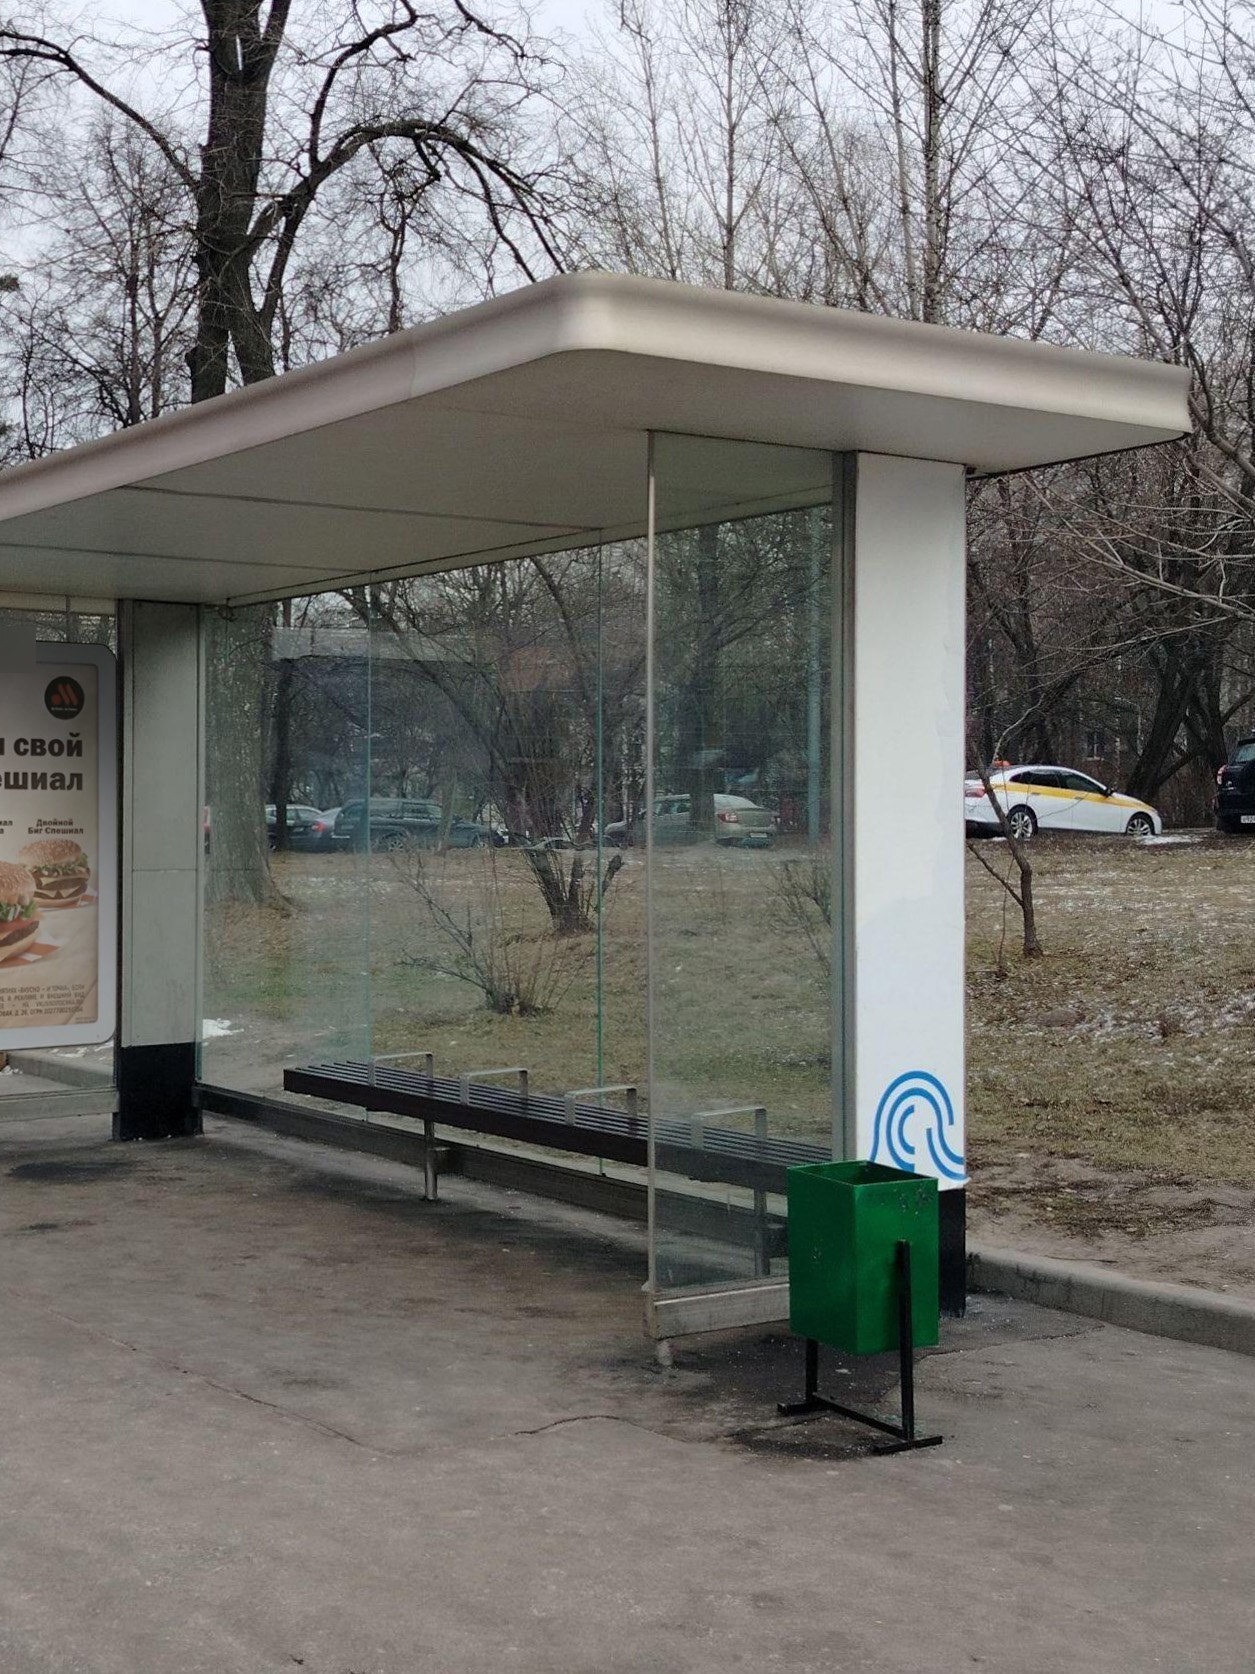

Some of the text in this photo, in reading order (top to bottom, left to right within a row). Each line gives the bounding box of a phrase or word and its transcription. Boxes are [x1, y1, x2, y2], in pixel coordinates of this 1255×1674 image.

[13, 732, 83, 757] свой
[36, 818, 74, 827] Двойной
[28, 827, 84, 835] Биг Спешиал
